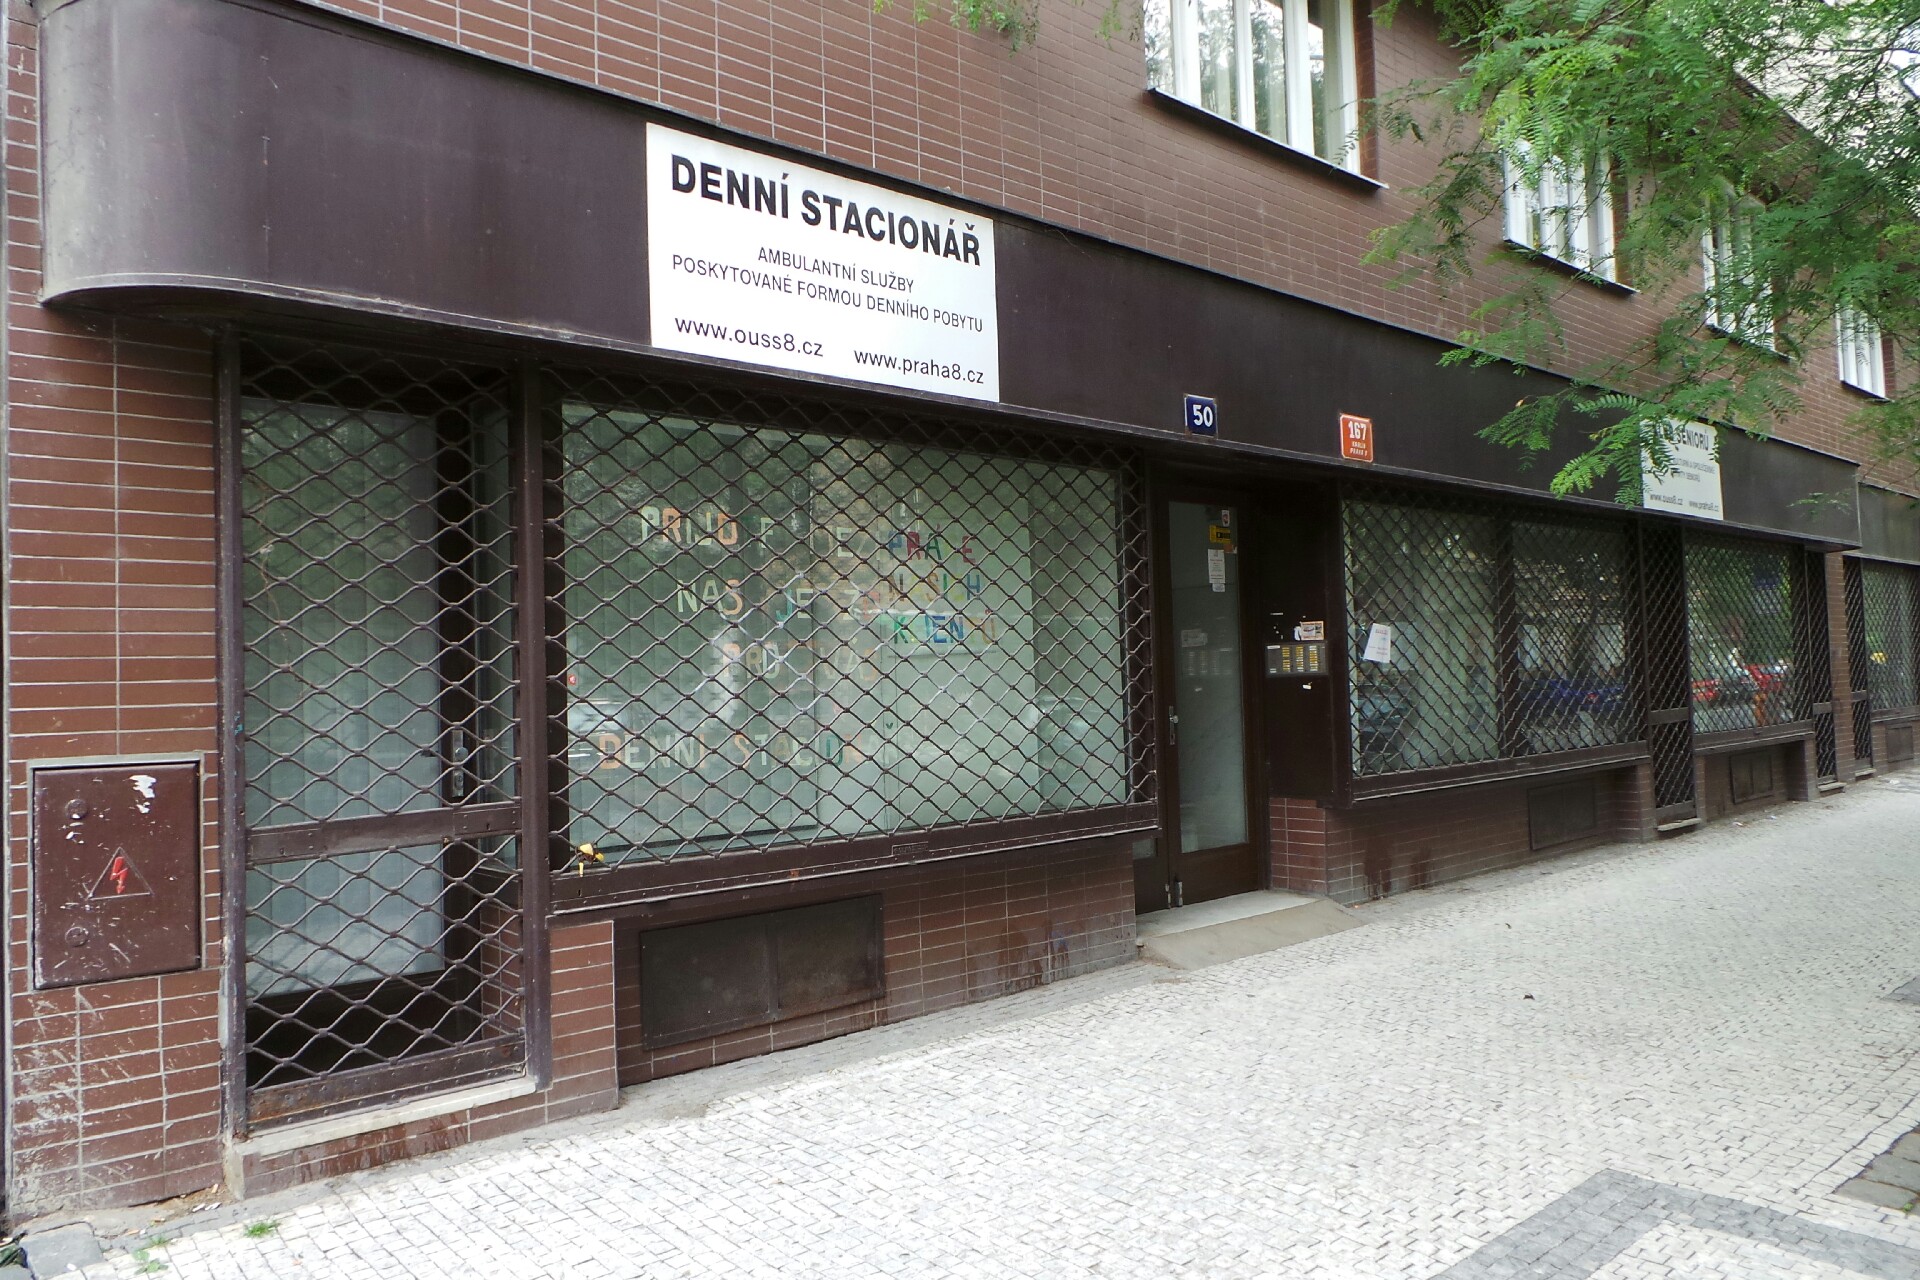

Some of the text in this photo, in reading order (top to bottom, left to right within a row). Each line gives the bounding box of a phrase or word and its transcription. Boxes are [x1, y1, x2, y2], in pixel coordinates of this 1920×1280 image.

[671, 154, 981, 266] DENNÍ STACIONÁŘ
[672, 255, 983, 332] POSKYTOVANÉ FORMOU DENNÍHO POBYTU
[758, 247, 914, 293] AMBULANTNÍ SLUŽBY
[675, 317, 984, 384] www.ouss8.cz www.praha8.cz
[1193, 404, 1214, 427] 50
[1348, 421, 1367, 440] 167
